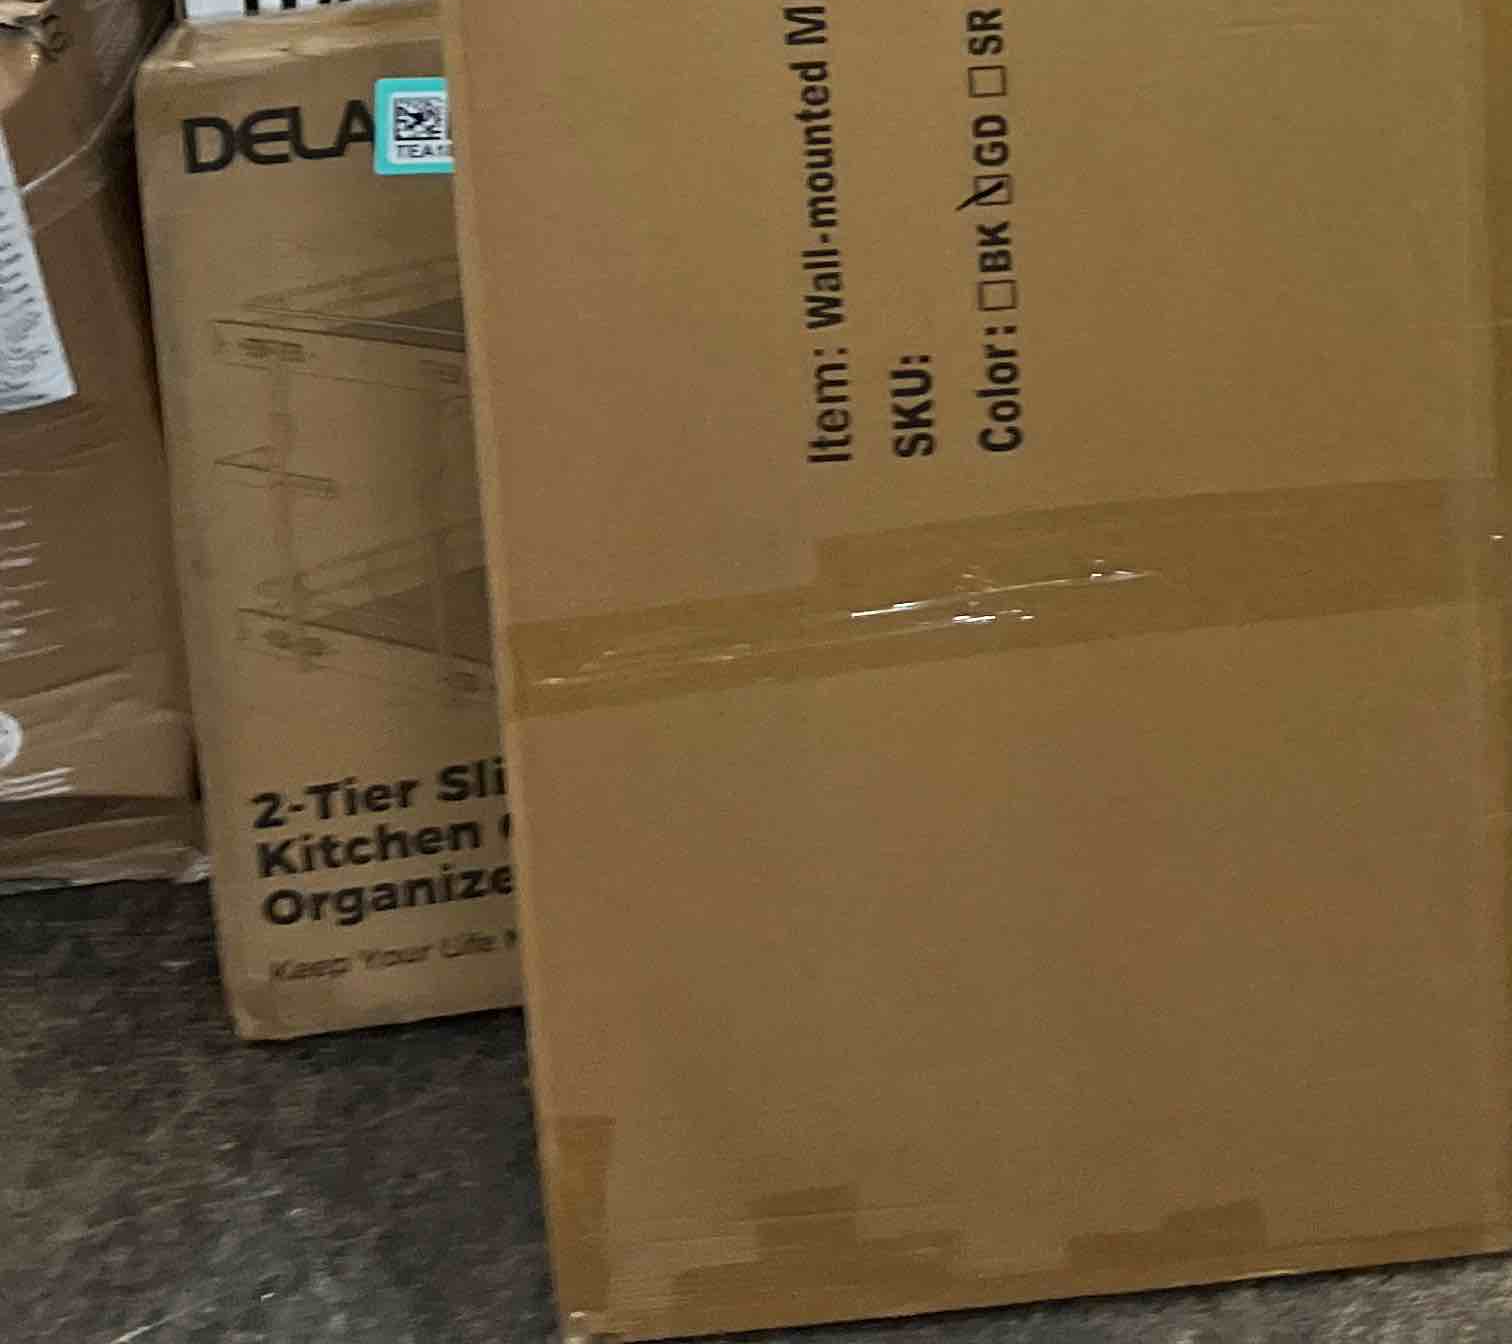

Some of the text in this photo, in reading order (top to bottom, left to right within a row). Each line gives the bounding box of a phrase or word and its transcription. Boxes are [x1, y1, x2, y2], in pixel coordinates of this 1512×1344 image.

[967, 9, 1003, 55] SR
[973, 115, 1009, 166] GD
[789, 61, 844, 329] Wall-mounted
[977, 222, 1012, 272] BK
[808, 348, 852, 462] Item:
[890, 355, 936, 457] SKU:
[976, 326, 1022, 452] Color:
[251, 776, 421, 830] 2-Tier
[256, 820, 480, 879] Kitchen
